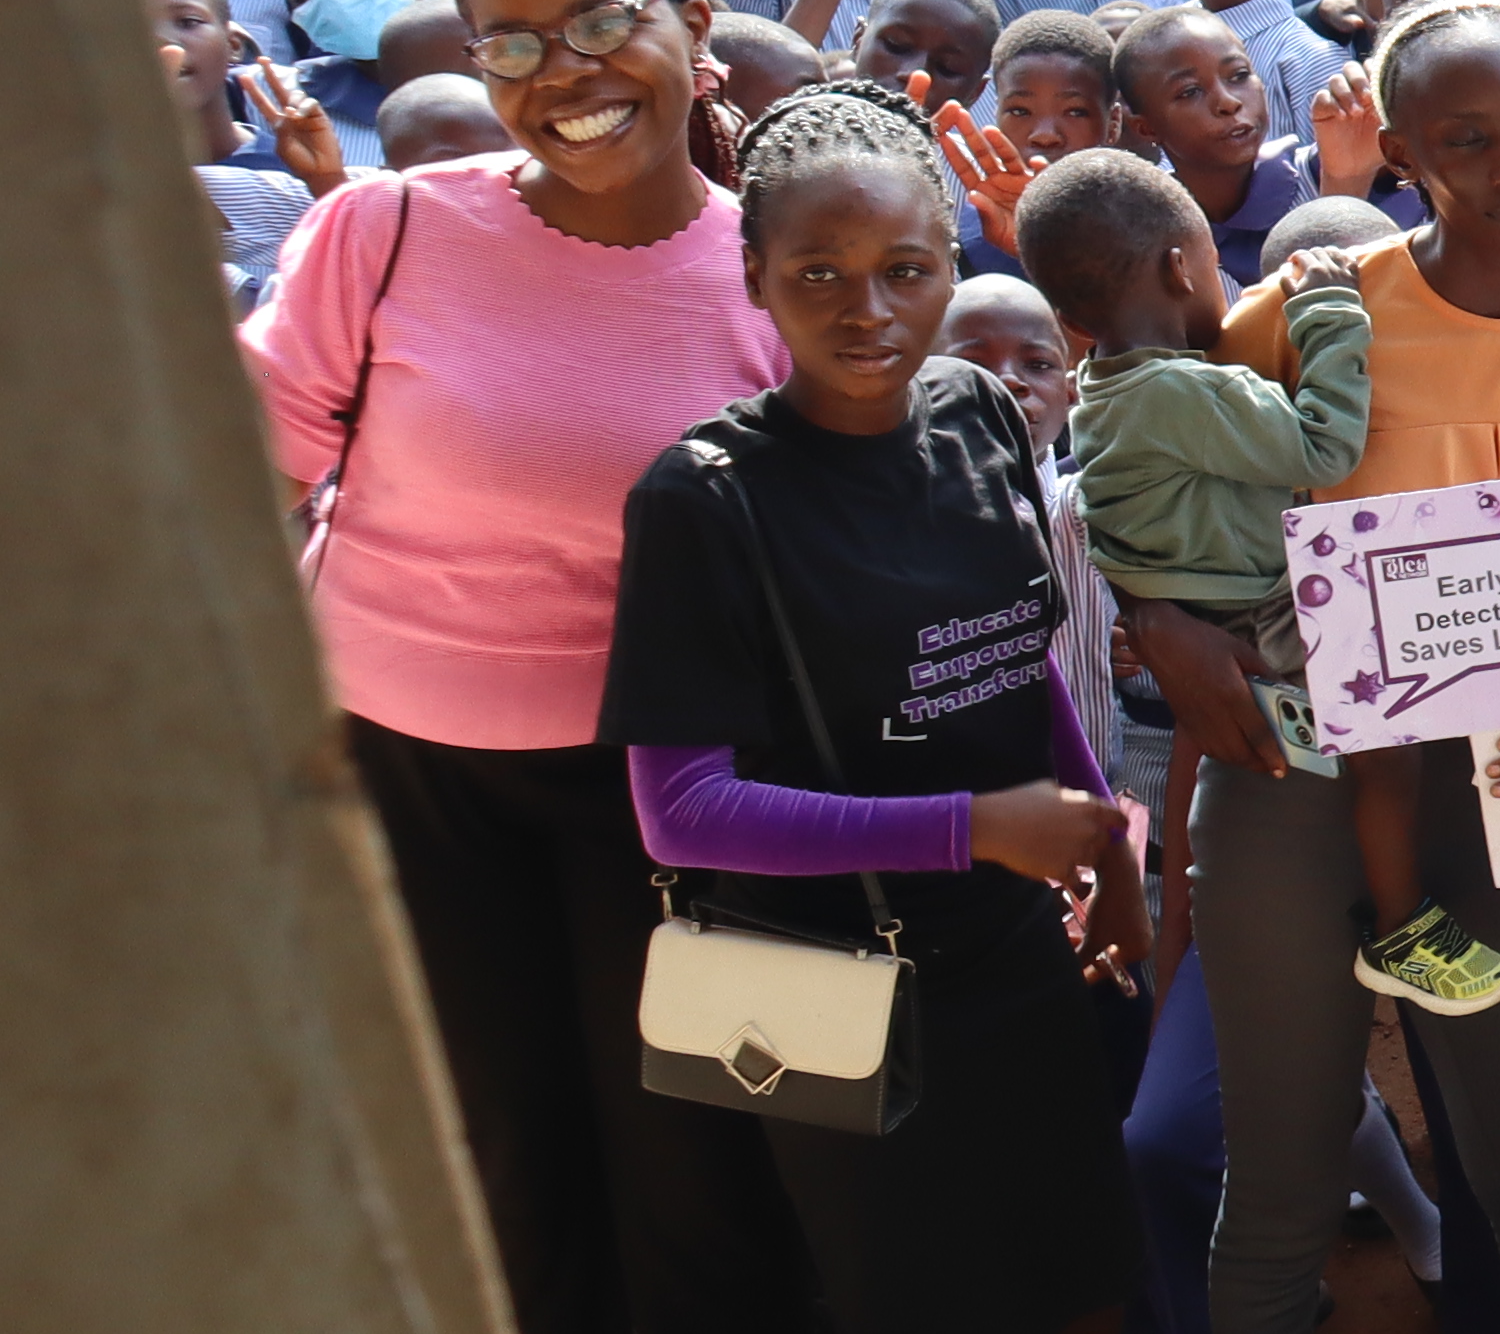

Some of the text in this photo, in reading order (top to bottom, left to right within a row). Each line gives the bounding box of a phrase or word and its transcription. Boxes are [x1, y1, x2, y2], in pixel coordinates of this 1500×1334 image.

[917, 599, 1042, 654] Educate
[1400, 636, 1484, 663] Saves
[908, 627, 1048, 690] Empower
